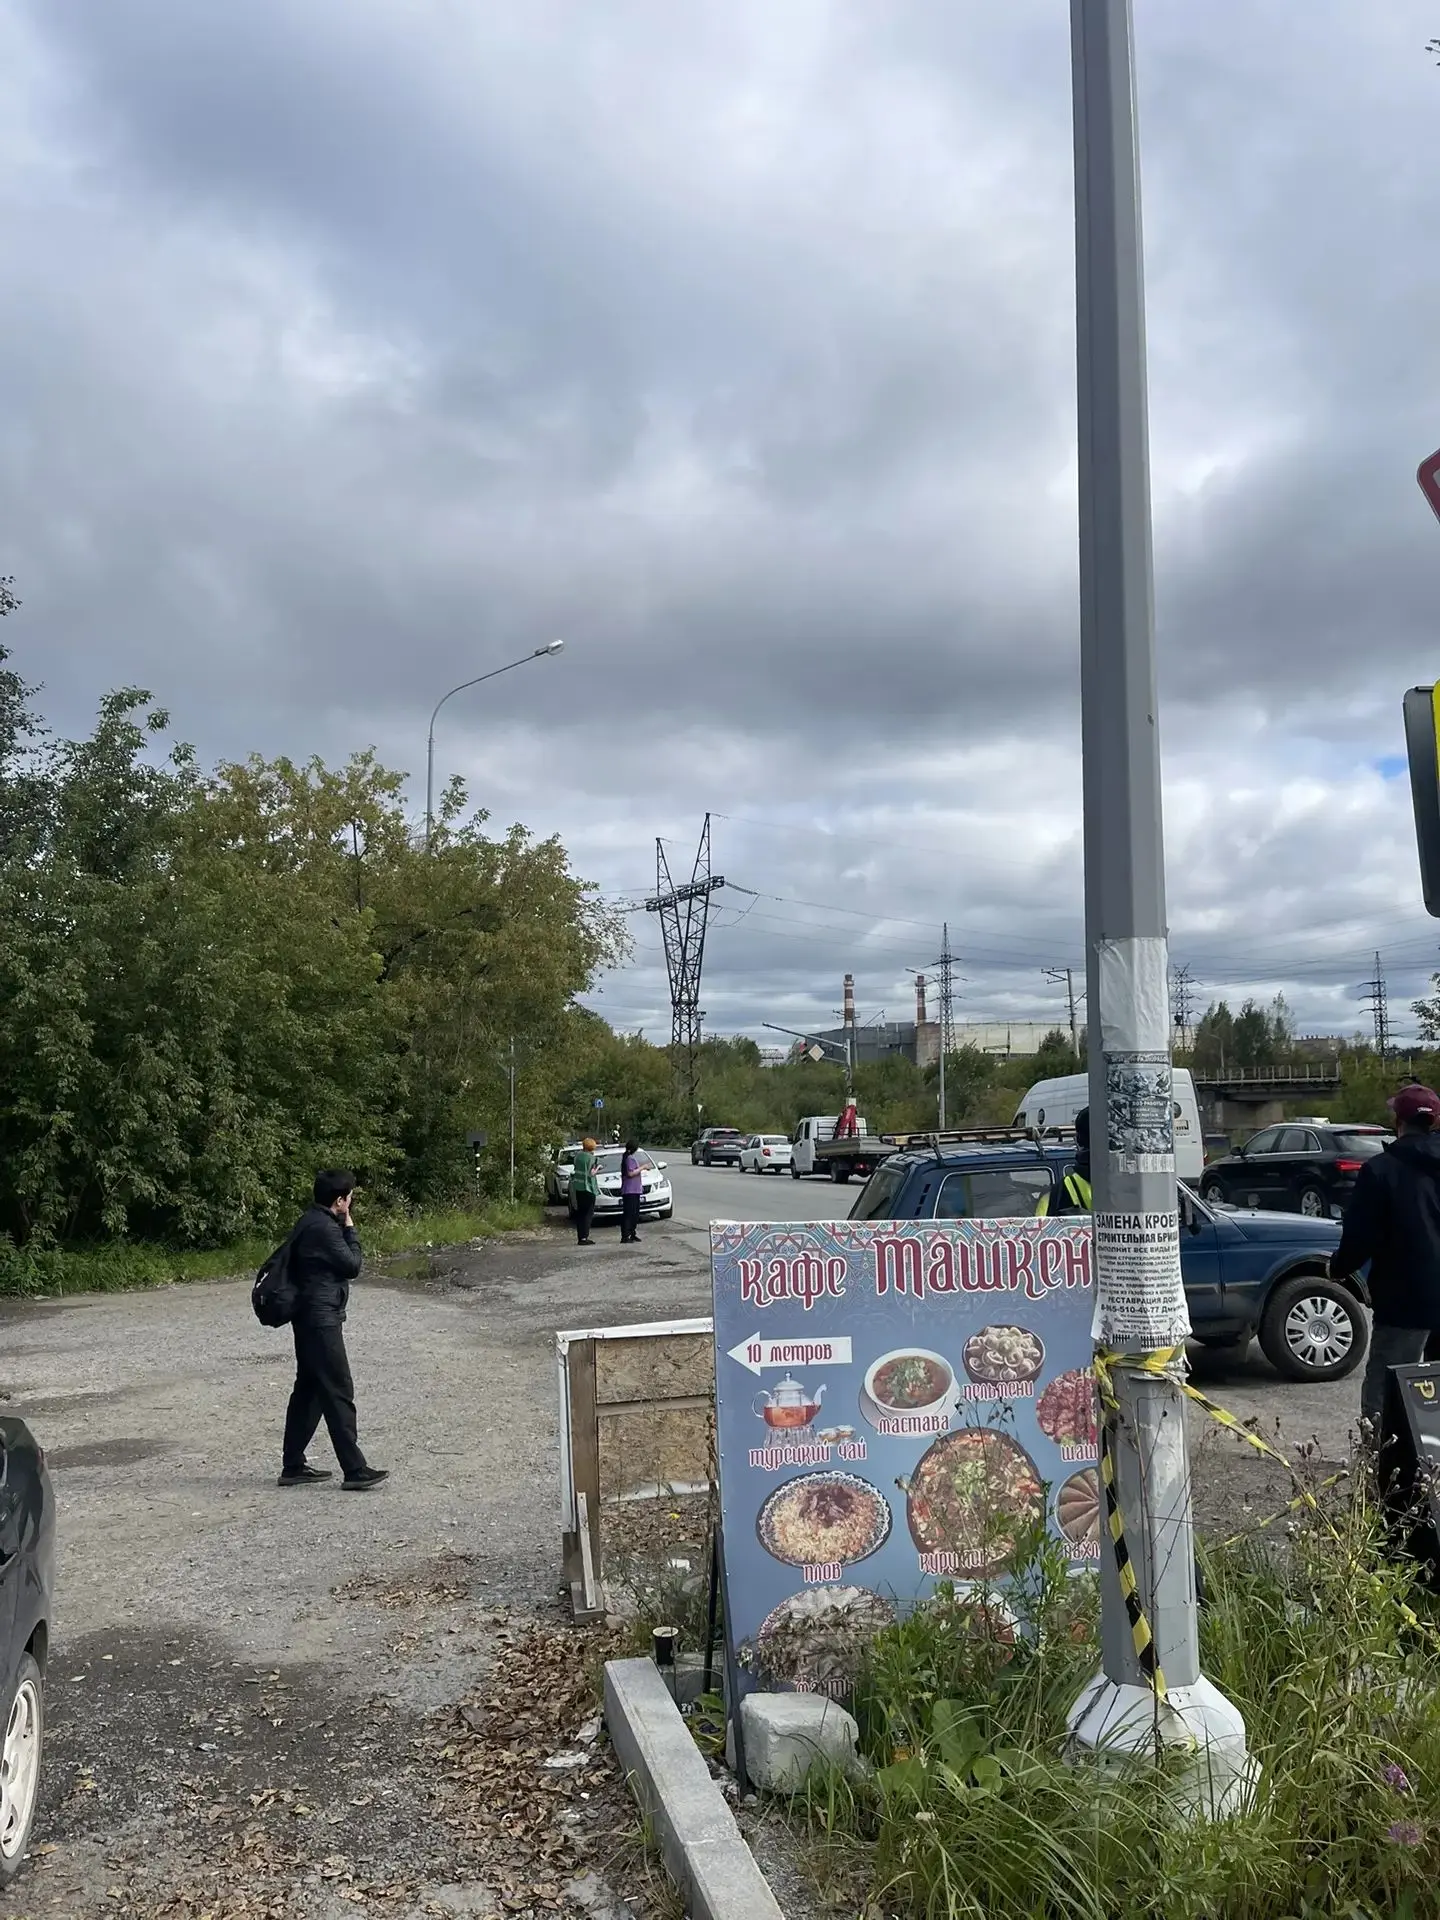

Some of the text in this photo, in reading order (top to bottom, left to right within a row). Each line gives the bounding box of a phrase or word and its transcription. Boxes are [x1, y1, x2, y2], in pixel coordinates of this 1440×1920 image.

[1096, 1214, 1177, 1229] ЗАМЕНА КРОВ
[1097, 1232, 1156, 1243] СТРОИТЕЛЬНАЯ
[740, 1252, 846, 1309] кафе
[747, 1343, 833, 1365] 10 метров
[963, 1381, 1035, 1402] пельмени
[878, 1415, 951, 1435] мастава
[750, 1437, 866, 1470] турецкий чай
[804, 1561, 842, 1584] плов
